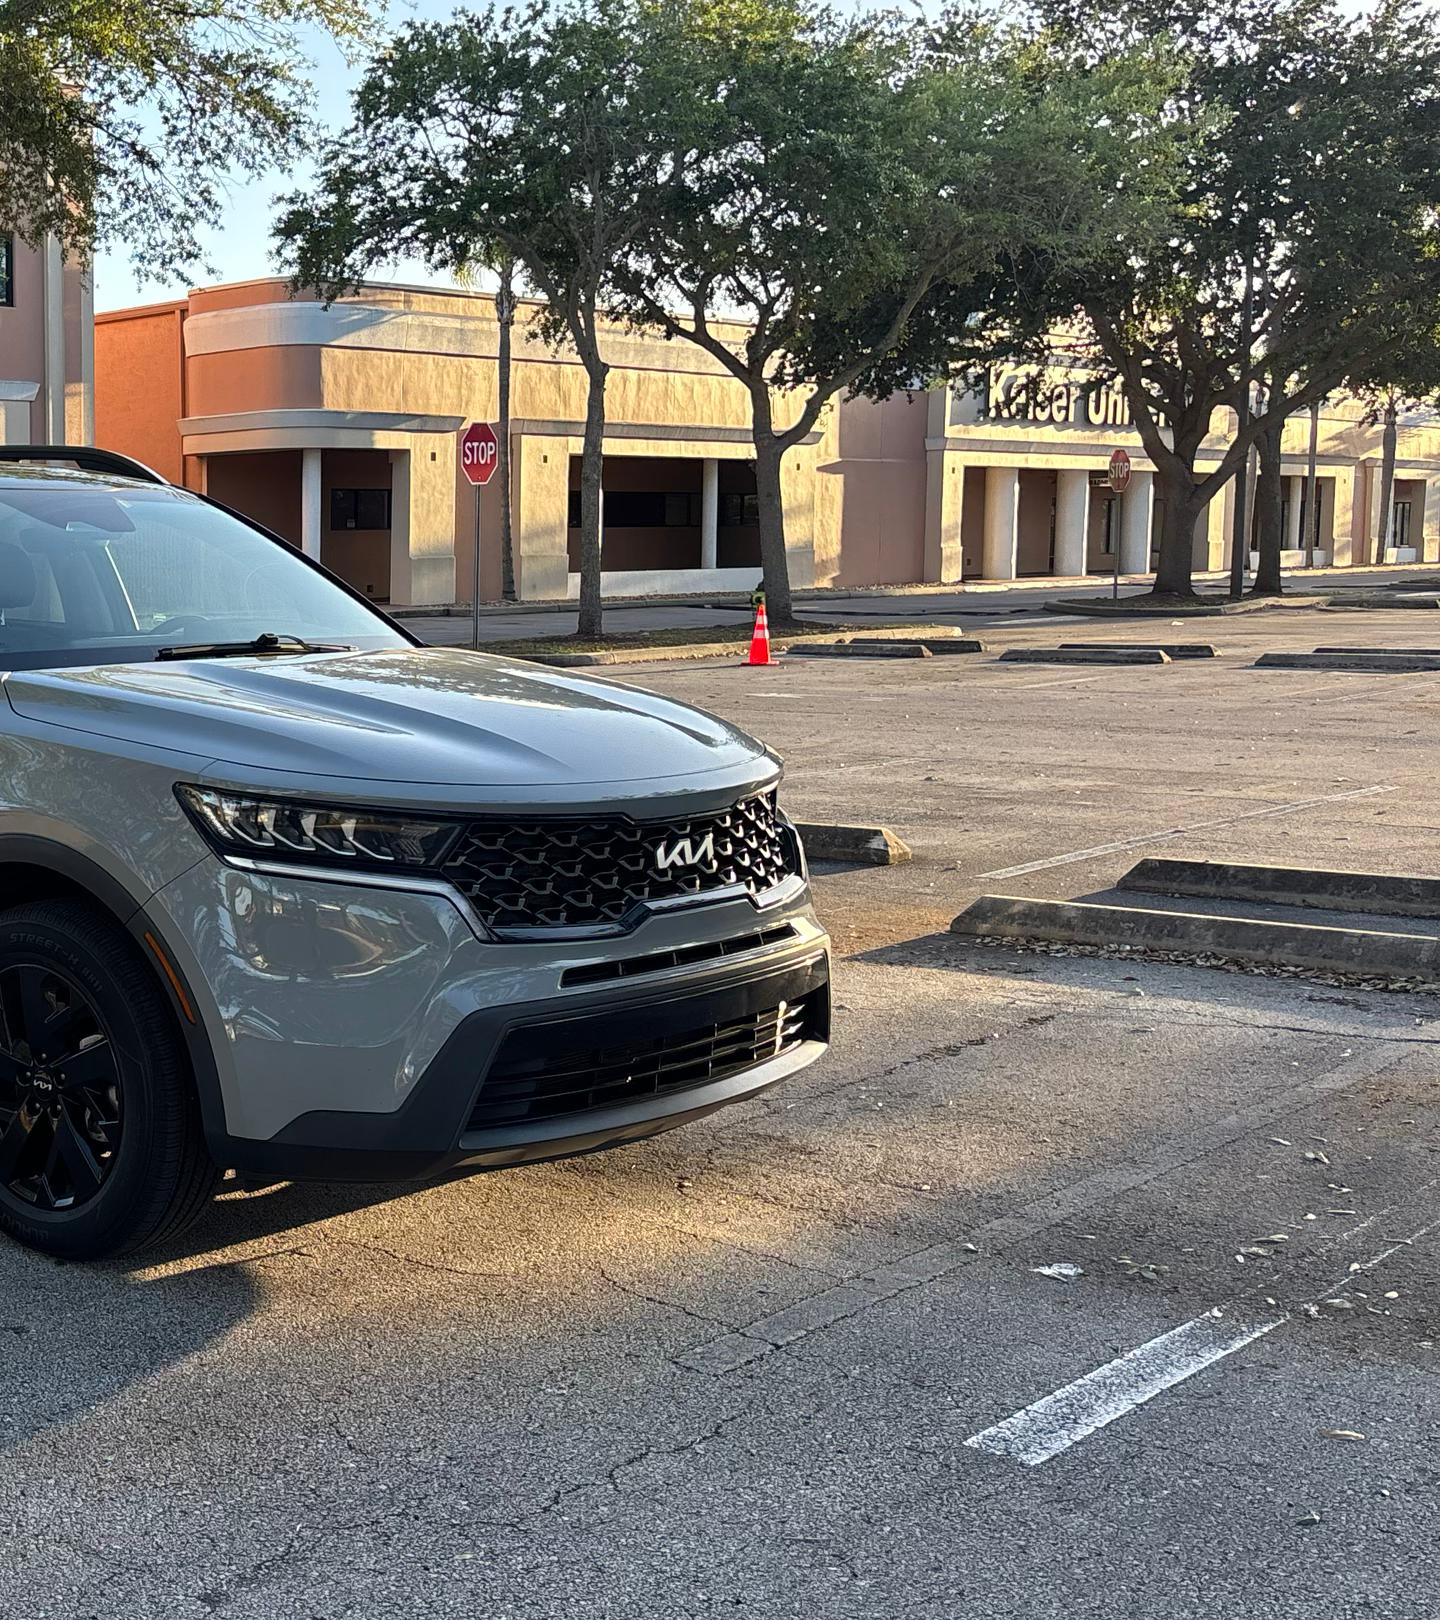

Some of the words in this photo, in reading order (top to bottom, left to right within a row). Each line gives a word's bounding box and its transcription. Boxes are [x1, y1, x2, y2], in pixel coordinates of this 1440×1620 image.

[464, 441, 496, 465] STOP
[1110, 462, 1130, 480] STOP
[656, 832, 715, 869] KIA
